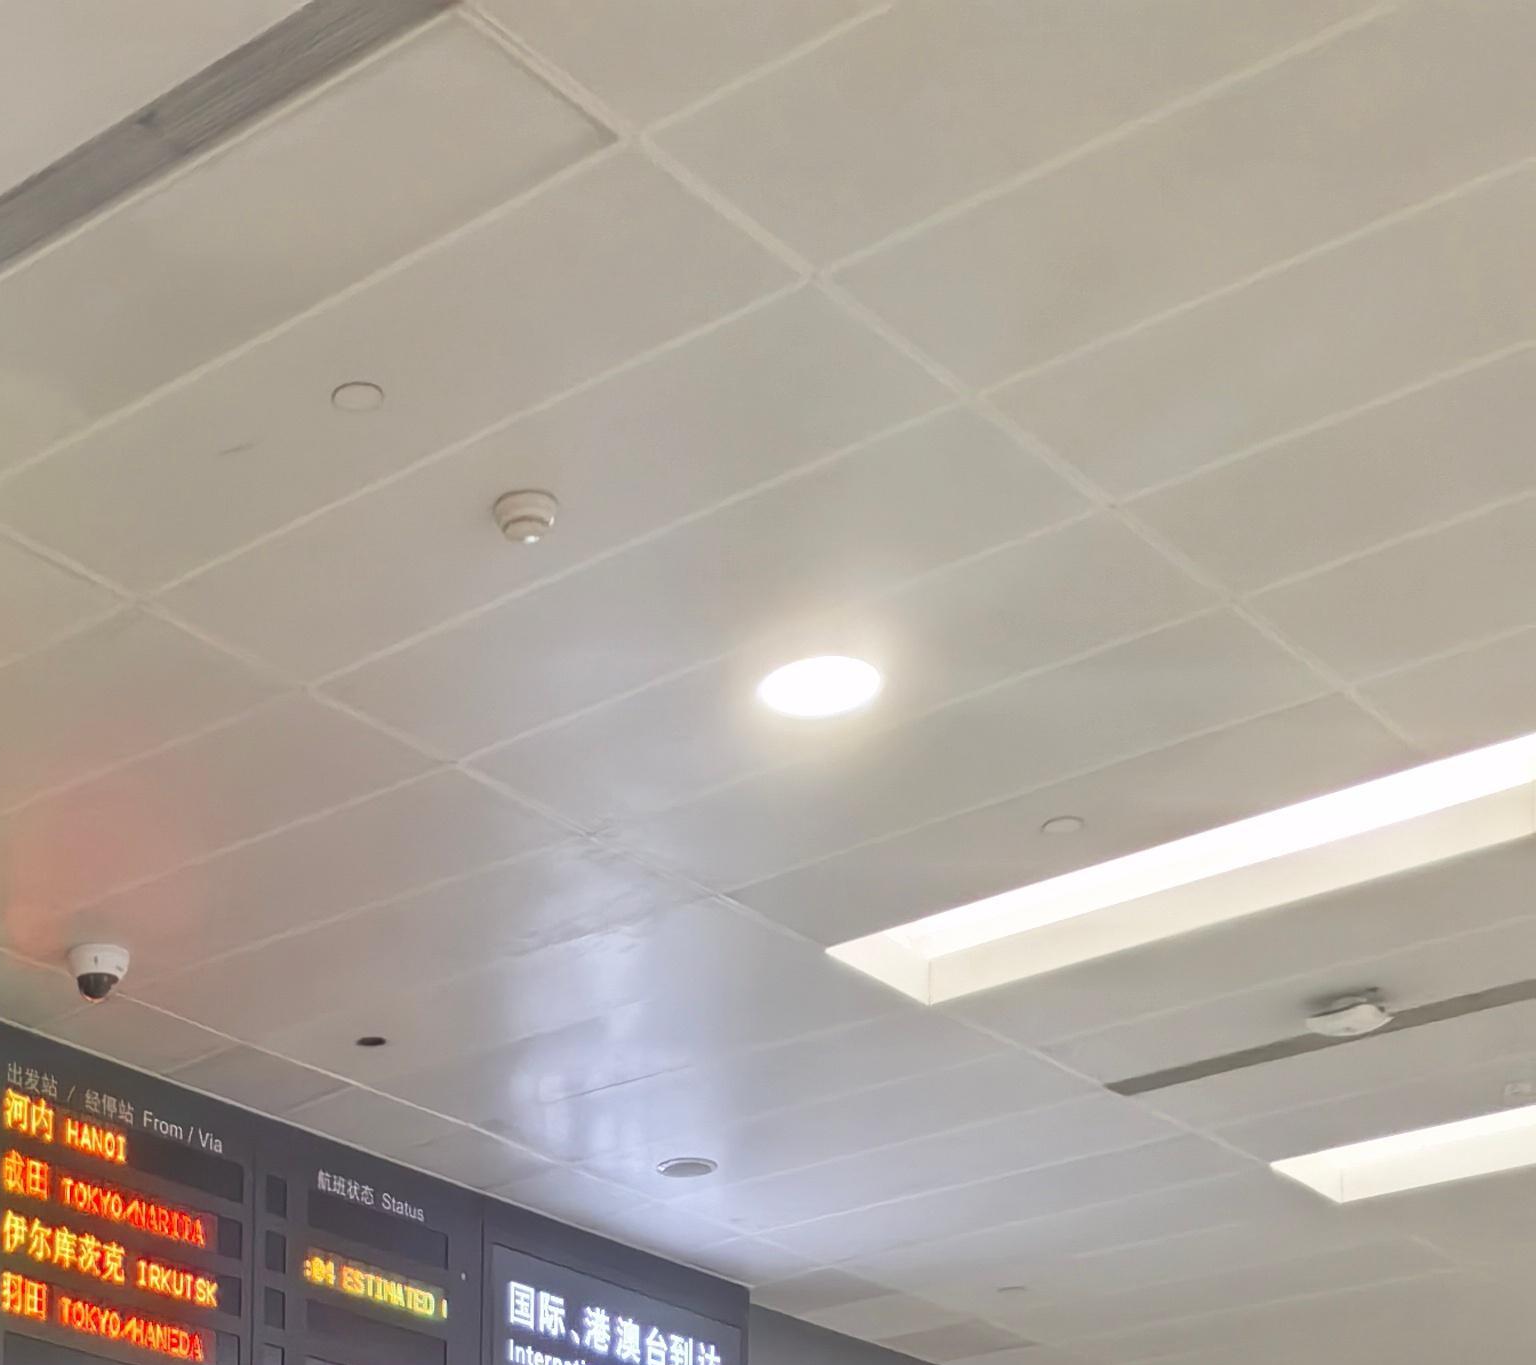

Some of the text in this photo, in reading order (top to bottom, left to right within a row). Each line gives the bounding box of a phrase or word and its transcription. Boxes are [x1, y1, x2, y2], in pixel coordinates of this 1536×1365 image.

[3, 1088, 126, 1164] 河内 HANOI
[6, 1061, 59, 1099] 出发站
[84, 1088, 135, 1126] 经停站
[144, 1110, 184, 1141] From
[198, 1131, 223, 1155] Via
[2, 1150, 205, 1248] 成田 TOKYO/NARITA
[318, 1169, 425, 1222] 航班状态 Status
[3, 1210, 218, 1308] 伊尔库茨克 IRKUTSK
[342, 1264, 435, 1317] ESTIMATED
[2, 1271, 203, 1362] 羽田 TOKYO/HANEDA
